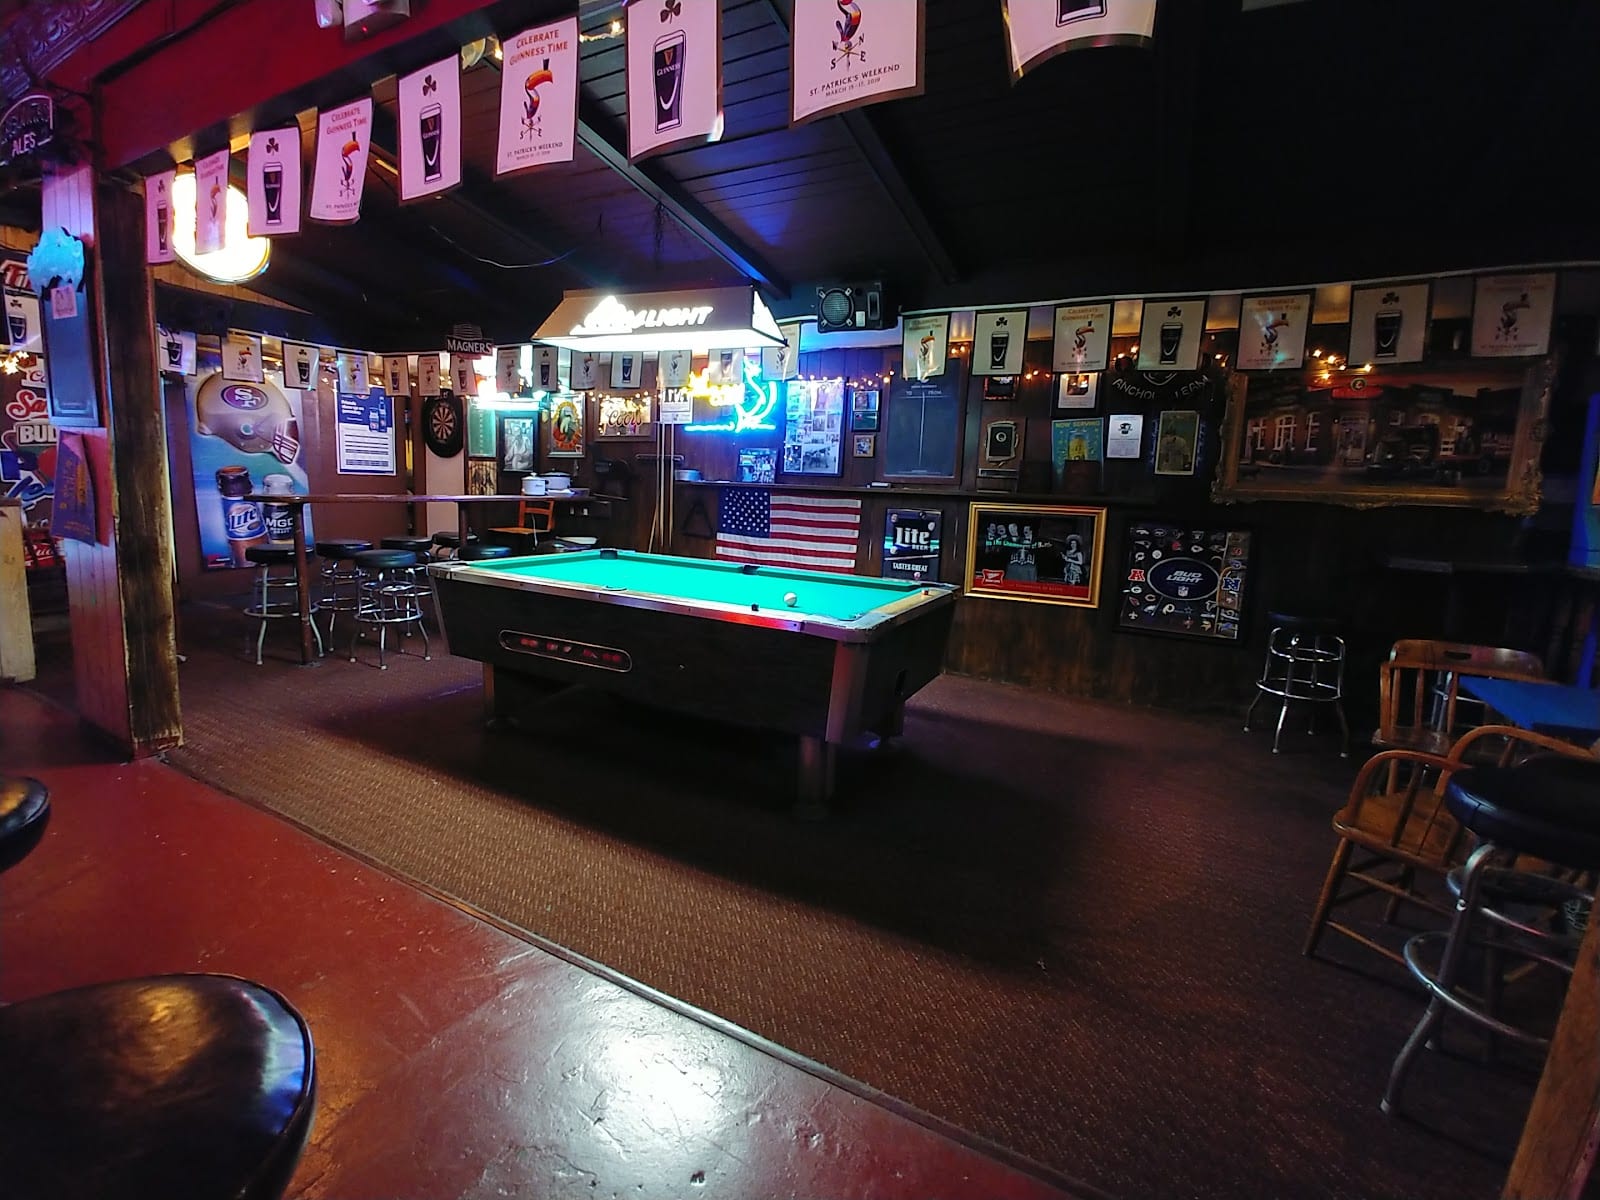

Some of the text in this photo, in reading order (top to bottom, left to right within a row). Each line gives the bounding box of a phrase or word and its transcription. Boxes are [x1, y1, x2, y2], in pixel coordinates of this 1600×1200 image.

[516, 29, 560, 49] CELEBRATE
[509, 41, 568, 66] GUINNESS TIME
[860, 50, 866, 62] E
[830, 58, 836, 70] S
[821, 74, 859, 92] PATRICK'S
[861, 64, 900, 79] WEEKEND
[825, 87, 847, 97] MARCH
[331, 107, 360, 122] CELEBRATE
[327, 117, 367, 135] GUINNESS TIME
[11, 132, 37, 158] ALES
[538, 142, 563, 152] WEEKEND
[645, 306, 713, 328] LIGHT
[446, 338, 492, 354] MAGNERS
[608, 408, 643, 427] Coors
[229, 508, 257, 531] Lite
[895, 527, 930, 547] Lite
[1166, 576, 1205, 584] LIGHT
[1173, 570, 1203, 578] BUD
